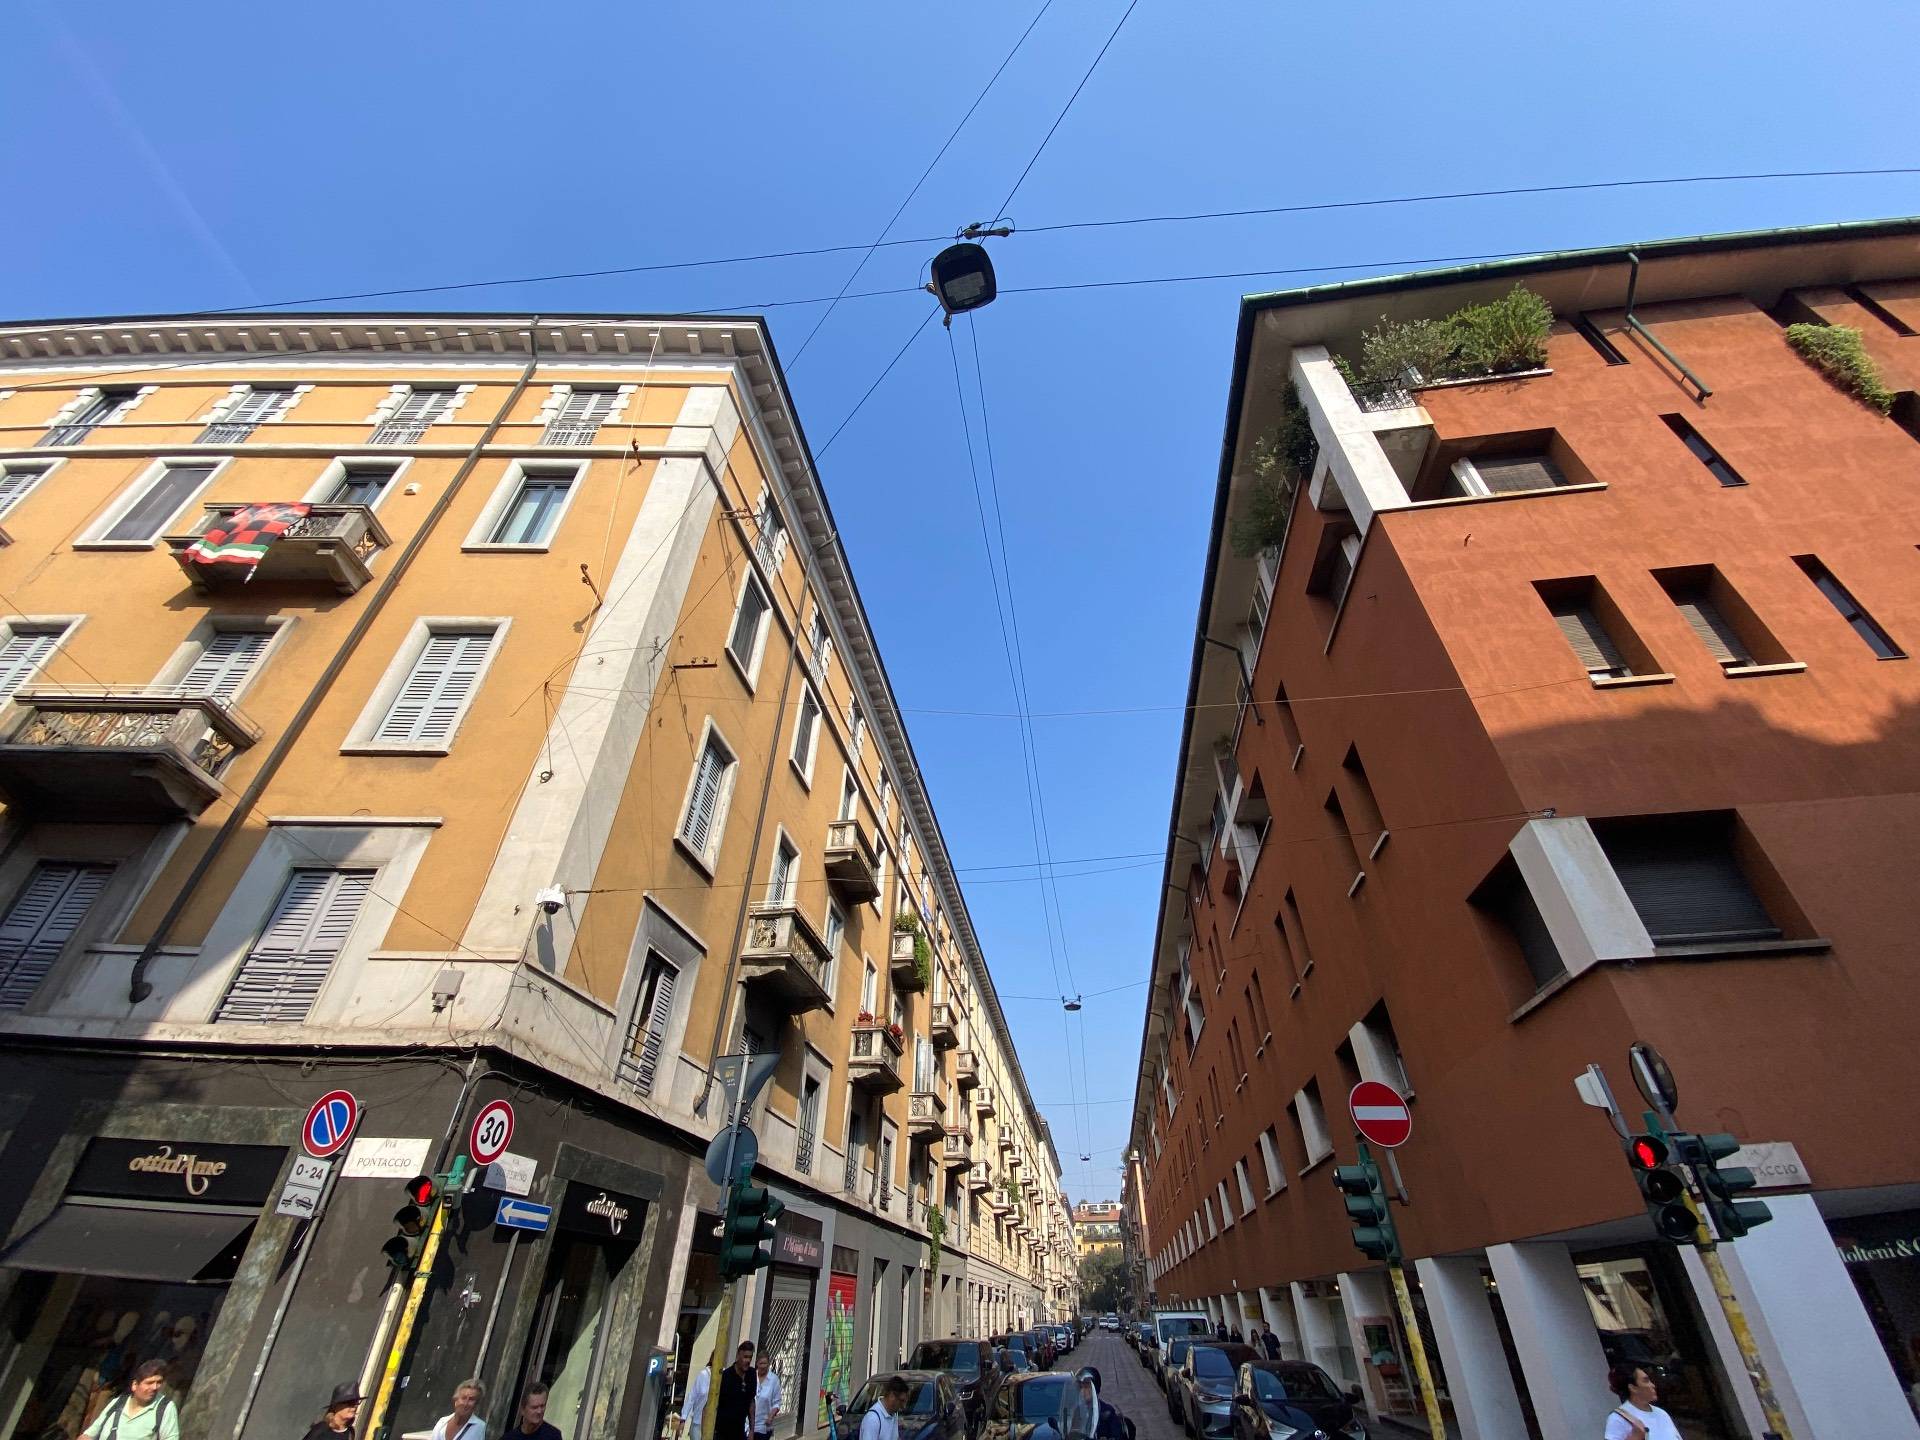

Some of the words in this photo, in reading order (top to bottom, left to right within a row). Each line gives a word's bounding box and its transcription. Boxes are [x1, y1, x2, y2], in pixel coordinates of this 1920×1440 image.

[480, 1116, 505, 1148] 30
[356, 1157, 412, 1169] PONTACCIO
[649, 1358, 658, 1374] P
